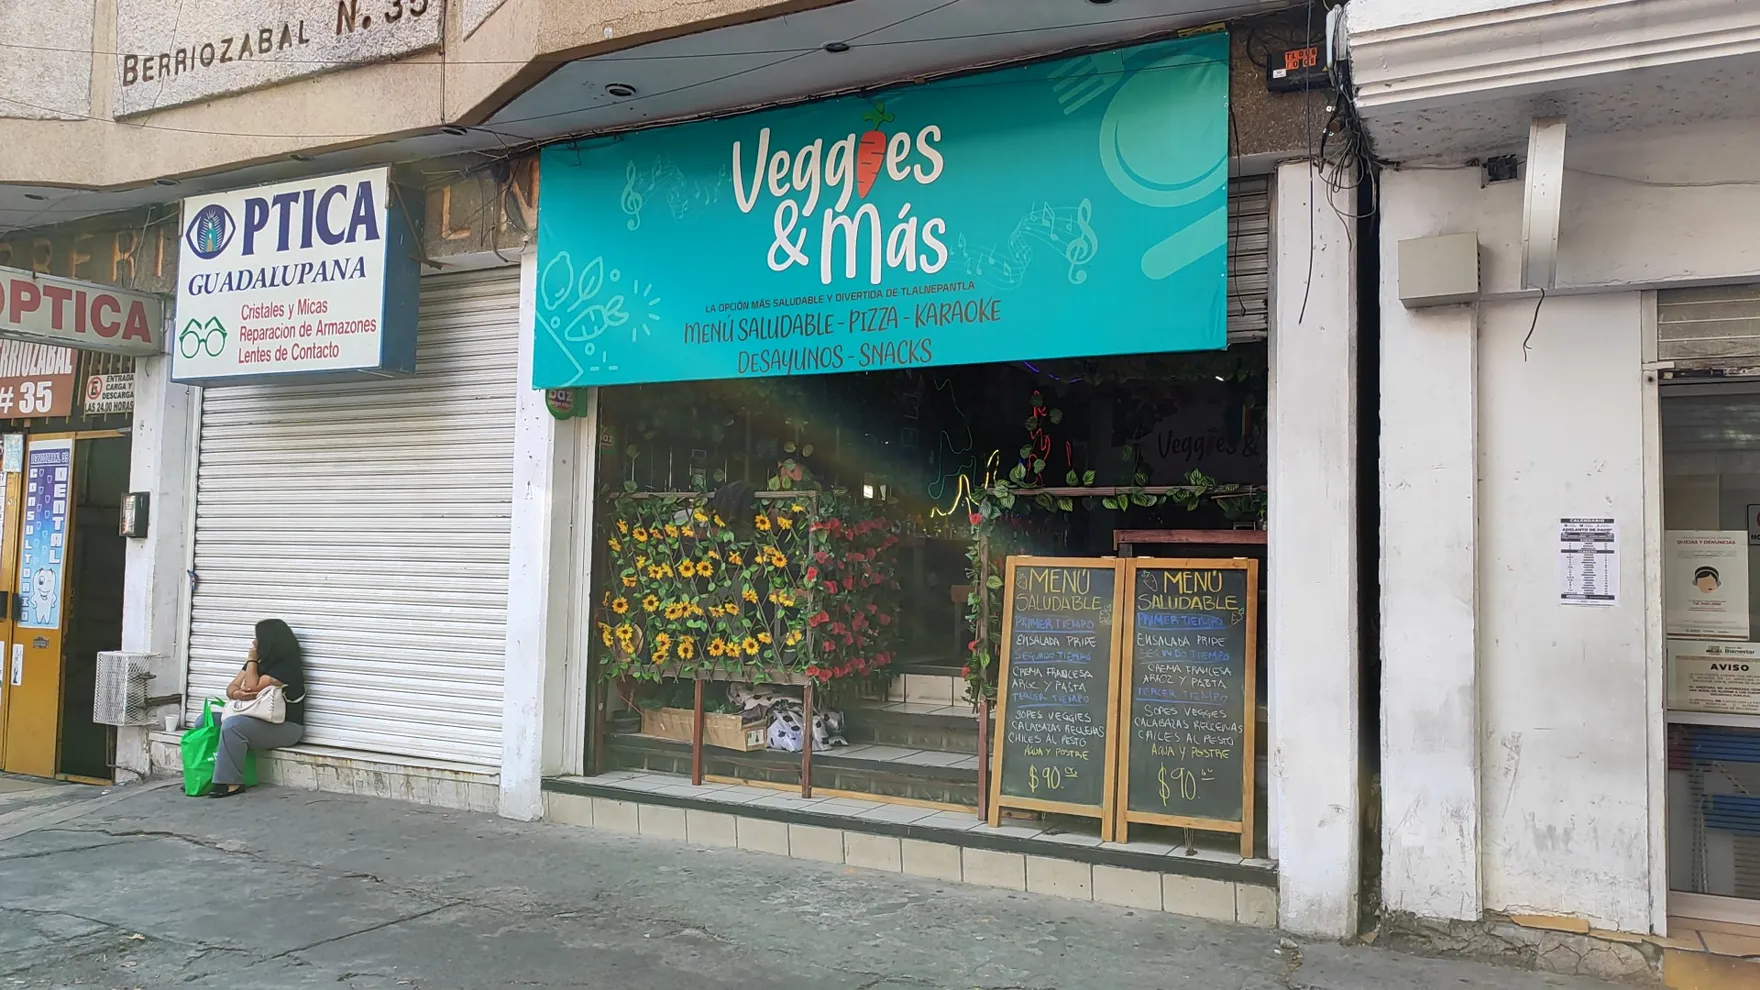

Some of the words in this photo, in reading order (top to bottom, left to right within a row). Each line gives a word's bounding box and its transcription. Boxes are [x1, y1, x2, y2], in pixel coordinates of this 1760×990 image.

[123, 19, 310, 87] BERRIOZABAL
[732, 125, 944, 216] Veggies
[767, 199, 809, 272] &
[820, 203, 948, 284] Más
[188, 256, 367, 296] GUADALUPANA
[705, 304, 716, 313] LA
[718, 301, 749, 312] OPCIÓN
[751, 298, 770, 309] MÁS
[773, 294, 824, 308] SALUDABLE
[827, 294, 833, 302] Y
[835, 289, 883, 302] DIVERTIDA
[886, 288, 898, 297] DE
[901, 281, 976, 296] TLALNEPANTLA
[0, 279, 152, 344] PTICA
[241, 301, 284, 321] Cristales
[288, 303, 294, 320] y
[297, 298, 328, 315] Micas
[684, 314, 734, 344] MENÚ
[738, 312, 834, 342] SALUDABLE
[849, 306, 899, 333] PIZZA
[915, 297, 1002, 329] KARAOKE
[239, 323, 296, 344] Reparacion
[299, 321, 312, 338] de
[316, 318, 377, 337] Armazones
[0, 339, 72, 378] RRIOZABAL
[238, 346, 271, 364] Lentes
[275, 345, 288, 361] de
[291, 341, 339, 361] Contacto
[738, 344, 844, 375] DESAYUNOS
[858, 338, 932, 367] SNACKS
[107, 374, 134, 383] ENTRADA
[105, 383, 126, 391] CARGA
[19, 381, 52, 414] 35
[102, 391, 134, 400] DESCARGA
[113, 401, 134, 411] HORAS
[1029, 568, 1090, 595] MENÚ
[1163, 570, 1223, 594] MENÚ
[1016, 593, 1102, 611] SALUDABLE
[1137, 593, 1239, 611] SALUDABLE
[1015, 616, 1053, 629] PRIMER
[1055, 618, 1095, 629] TIEMPO
[1137, 612, 1179, 627] PRIMER
[1016, 634, 1060, 647] ENSALADA
[1066, 636, 1096, 647] PRIDE
[1137, 632, 1190, 647] ENSALADA
[1197, 635, 1226, 647] PRIDE
[1012, 666, 1042, 678] CREMA
[1046, 667, 1093, 679] FRANCESA
[1147, 664, 1182, 673] CREMA
[1710, 663, 1750, 671] AVISO
[1044, 681, 1052, 692] Y
[1056, 681, 1087, 693] PASTA
[1179, 675, 1187, 686] Y
[1191, 677, 1227, 689] PASTA
[1015, 710, 1043, 720] SOPES
[1048, 712, 1091, 723] VEGGIES
[1144, 704, 1178, 717] SOPES
[1184, 707, 1227, 719] VEGGIES
[1012, 721, 1061, 733] CALABAZAS
[1134, 717, 1189, 730] CALABAZAS
[1008, 732, 1042, 744] CHILES
[1046, 733, 1057, 745] AL
[1138, 730, 1181, 743] CHILES
[1186, 732, 1200, 744] AL
[1045, 748, 1052, 756] Y
[1056, 747, 1089, 760] POSTRE
[1179, 747, 1186, 760] Y
[1191, 746, 1230, 759] POSTRE
